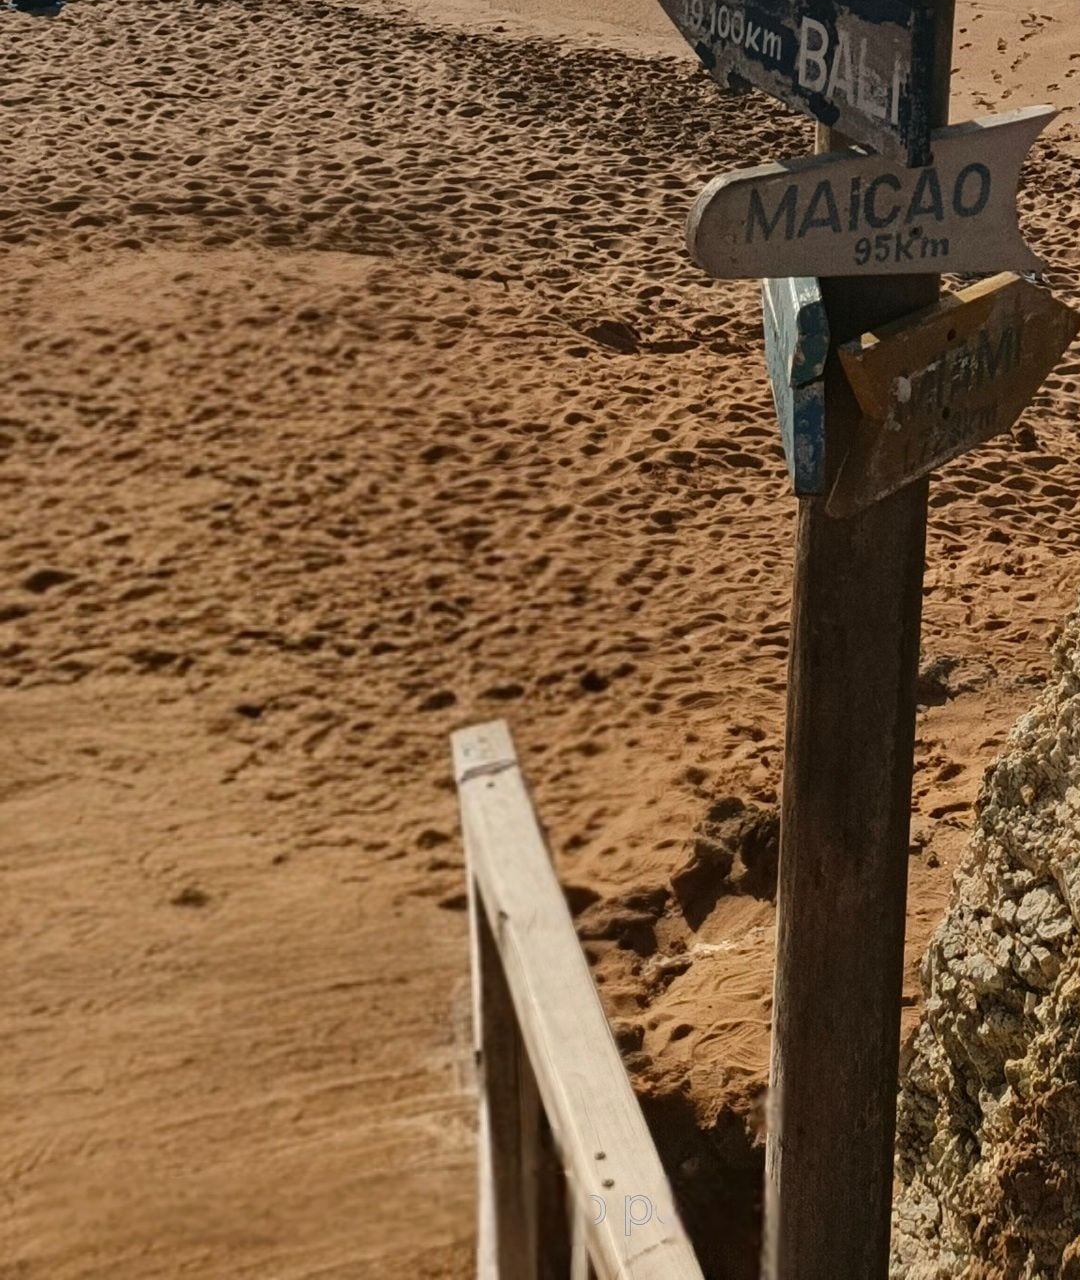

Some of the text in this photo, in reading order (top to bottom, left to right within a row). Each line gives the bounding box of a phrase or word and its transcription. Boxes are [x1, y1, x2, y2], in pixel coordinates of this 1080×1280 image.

[798, 15, 901, 126] BALI
[744, 162, 991, 245] MAICAO
[855, 232, 950, 266] 95km
